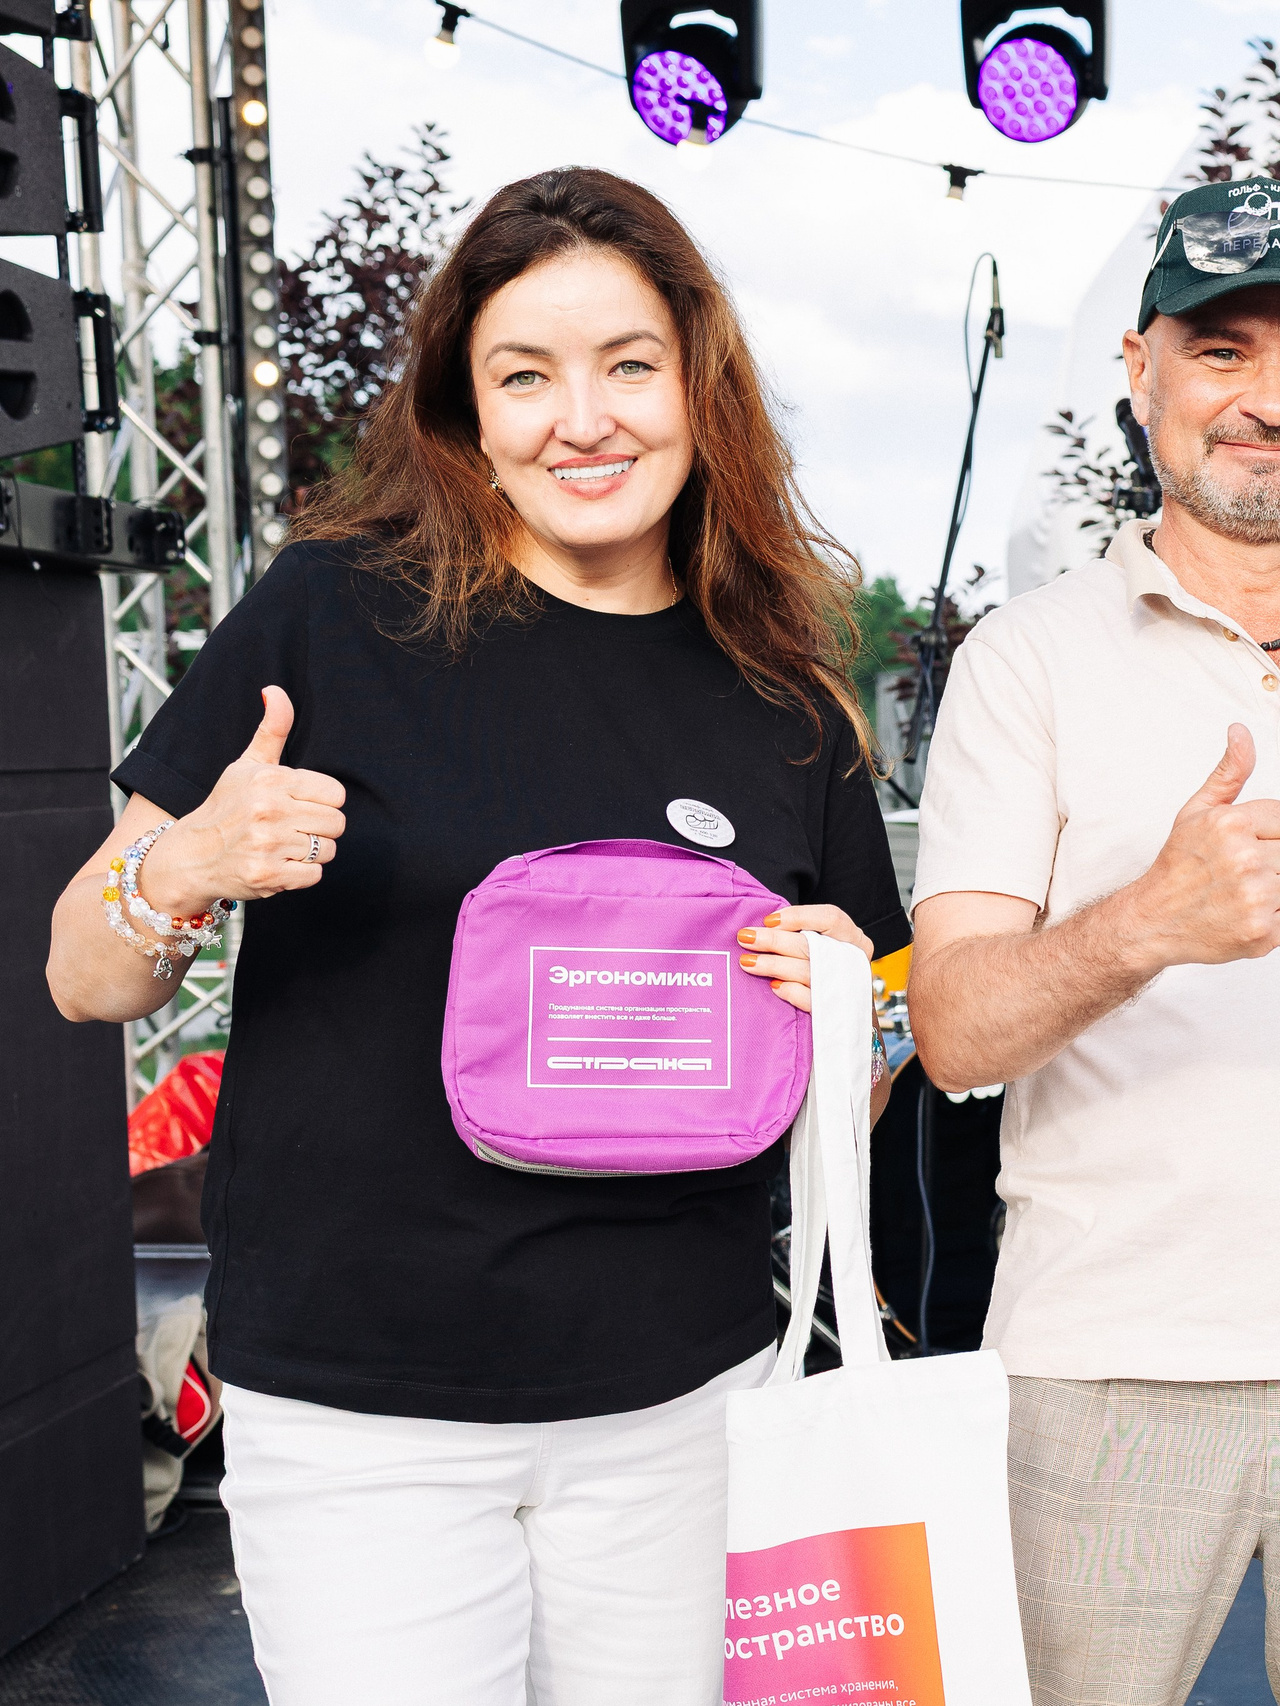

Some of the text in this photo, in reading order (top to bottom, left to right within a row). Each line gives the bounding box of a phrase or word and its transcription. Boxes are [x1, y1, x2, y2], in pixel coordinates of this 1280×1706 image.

[1228, 183, 1261, 198] ГОЛЬФ
[548, 965, 713, 987] Эргономика
[548, 1003, 595, 1012] Продуманная
[724, 1613, 905, 1661] остранство
[780, 1684, 838, 1703] система
[840, 1679, 899, 1696] хранения,
